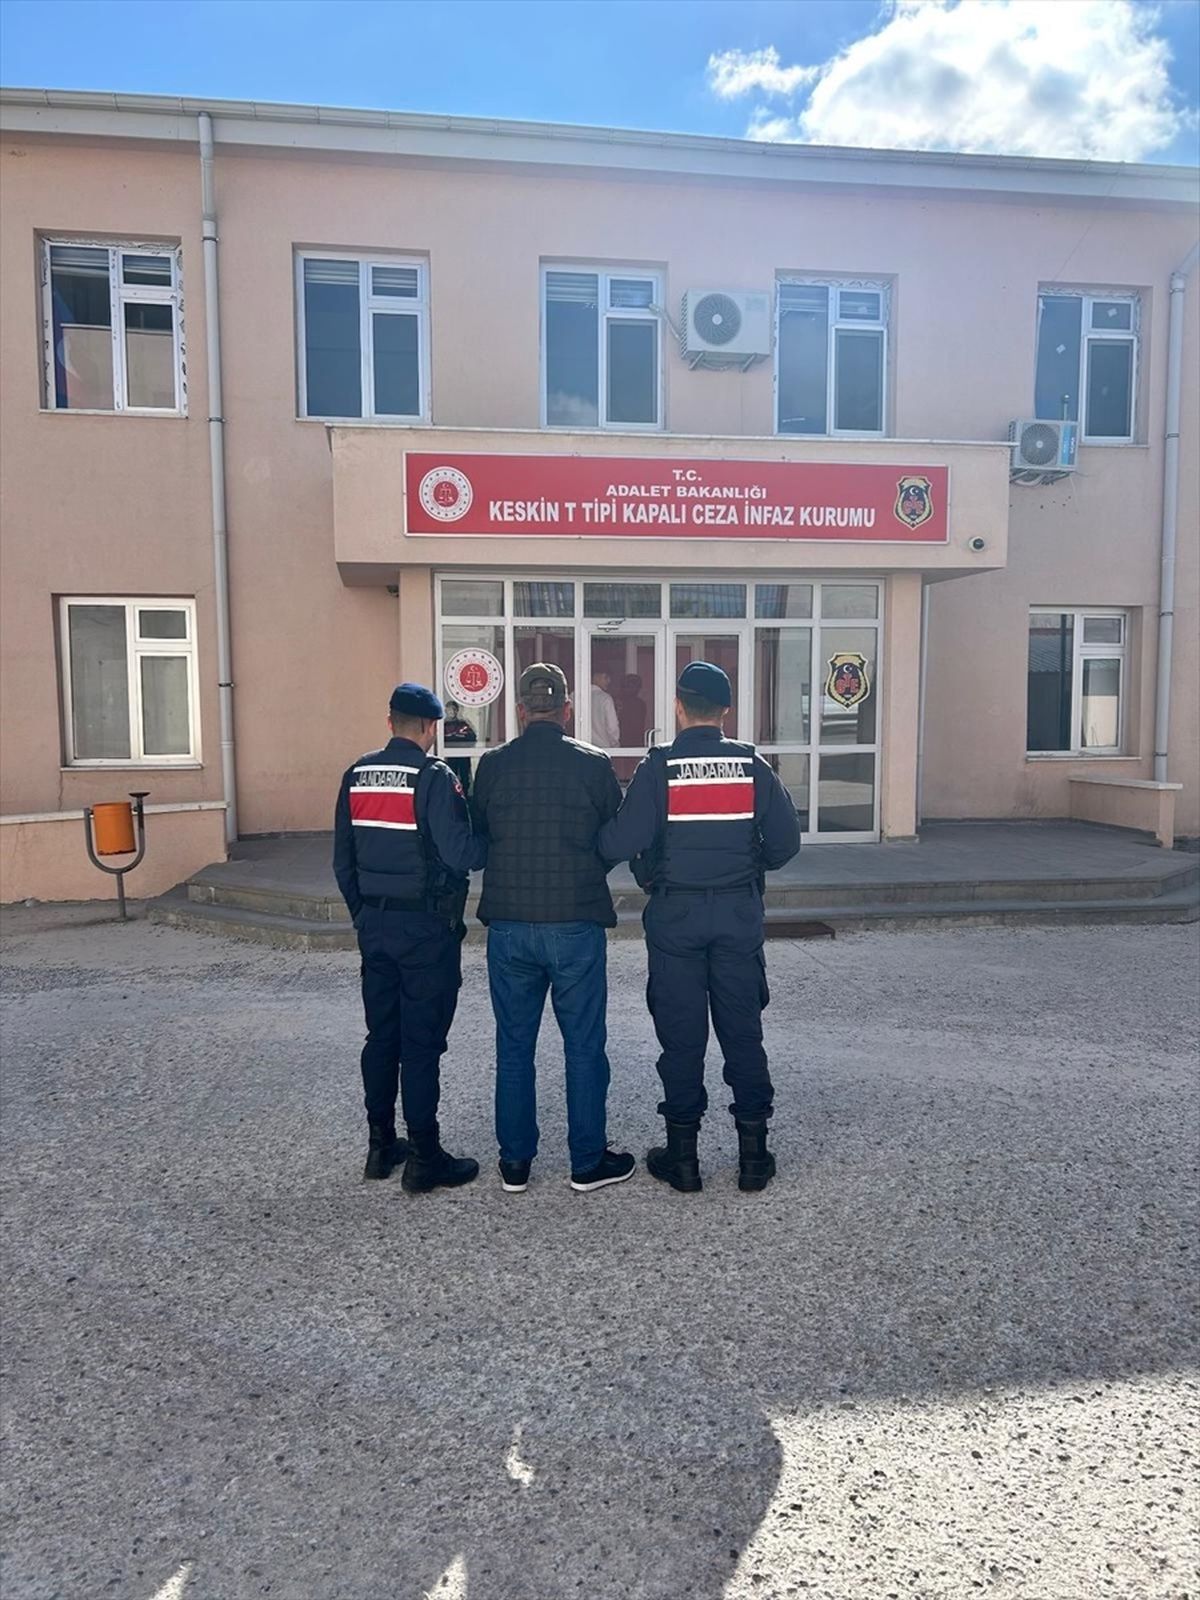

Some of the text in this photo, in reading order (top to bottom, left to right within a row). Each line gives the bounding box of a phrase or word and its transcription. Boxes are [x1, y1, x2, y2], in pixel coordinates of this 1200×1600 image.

[672, 469, 702, 481] T.C.
[606, 485, 766, 499] ADALET BAKANLIĞI
[489, 497, 875, 527] KESKİN T TİPİ KAPALI CEZA İNFAZ KURUMU
[356, 771, 407, 787] JANDARMA
[677, 763, 745, 779] JANDARMA
